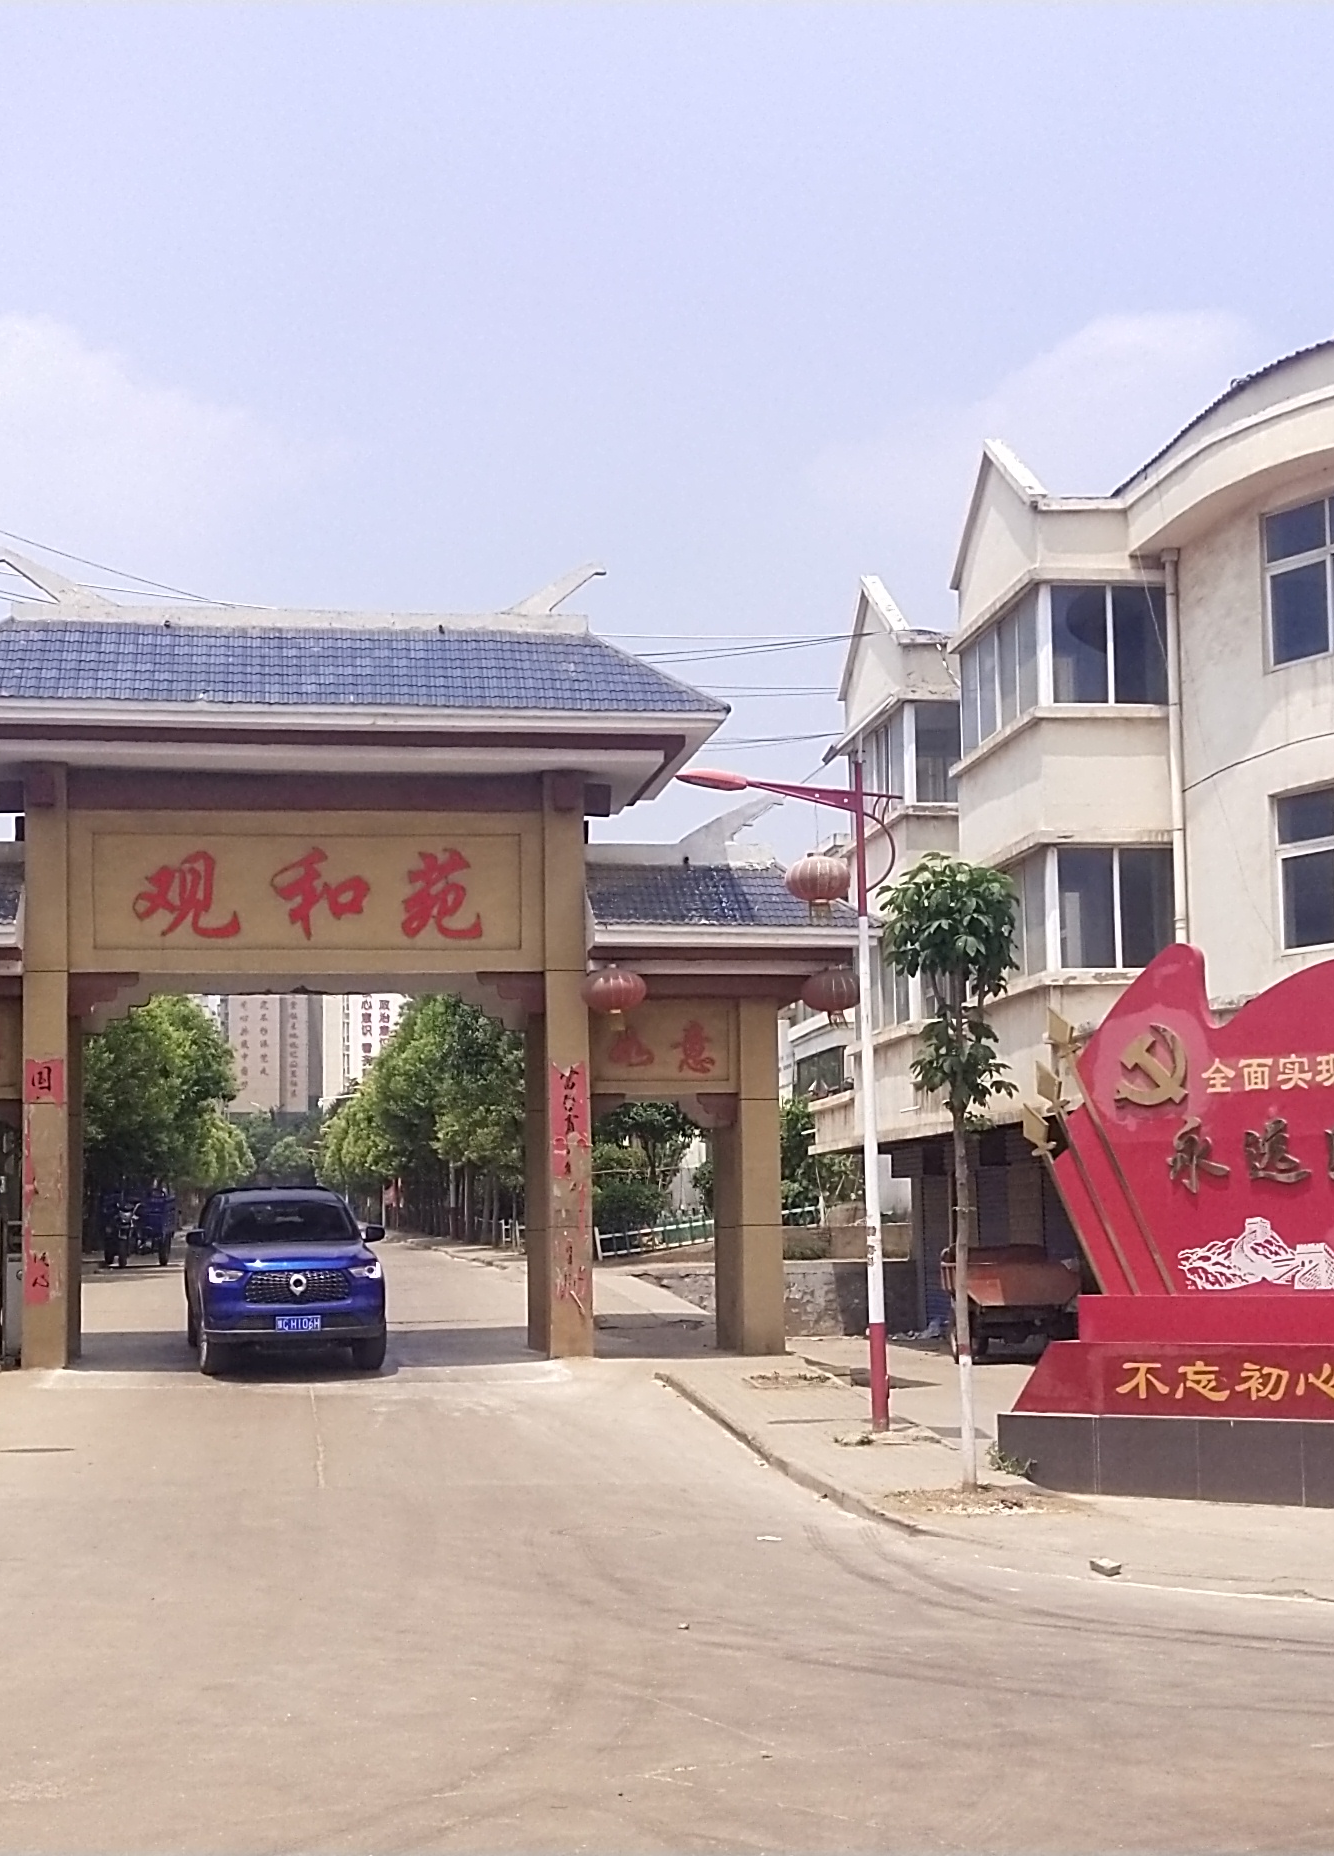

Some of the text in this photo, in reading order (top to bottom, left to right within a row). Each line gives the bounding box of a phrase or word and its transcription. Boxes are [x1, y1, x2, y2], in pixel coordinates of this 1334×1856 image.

[132, 848, 482, 940] 观和苑
[609, 1020, 717, 1075] 如意
